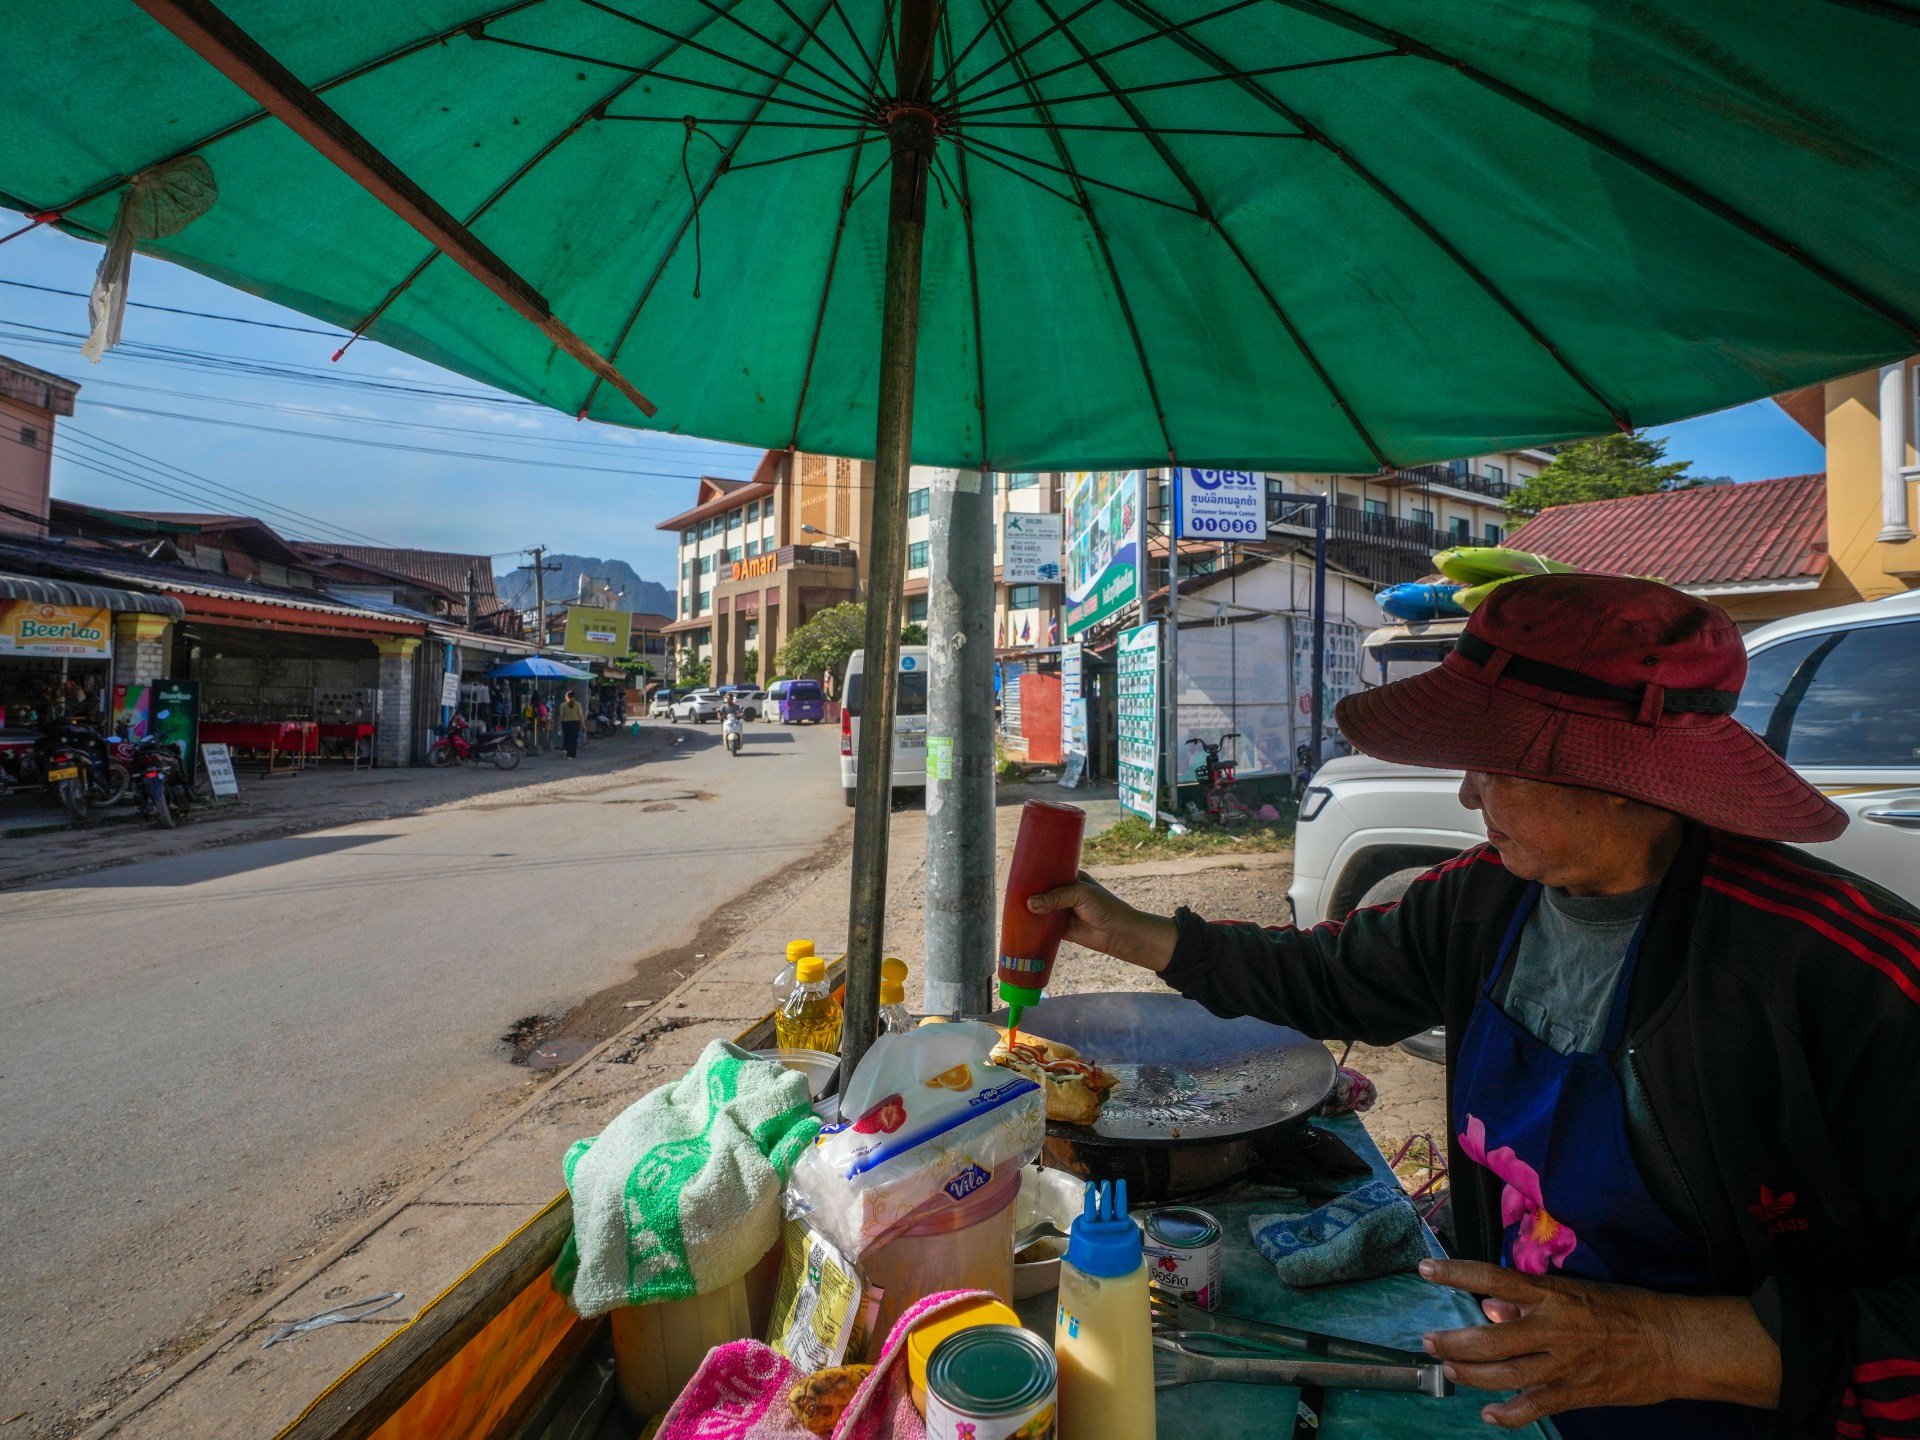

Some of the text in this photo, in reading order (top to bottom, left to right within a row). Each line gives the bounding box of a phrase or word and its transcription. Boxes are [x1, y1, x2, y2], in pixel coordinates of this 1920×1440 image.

[1192, 508, 1217, 516] Customer
[1192, 518, 1257, 533] 11833
[21, 619, 101, 640] Beerlao
[951, 1170, 985, 1198] Vila
